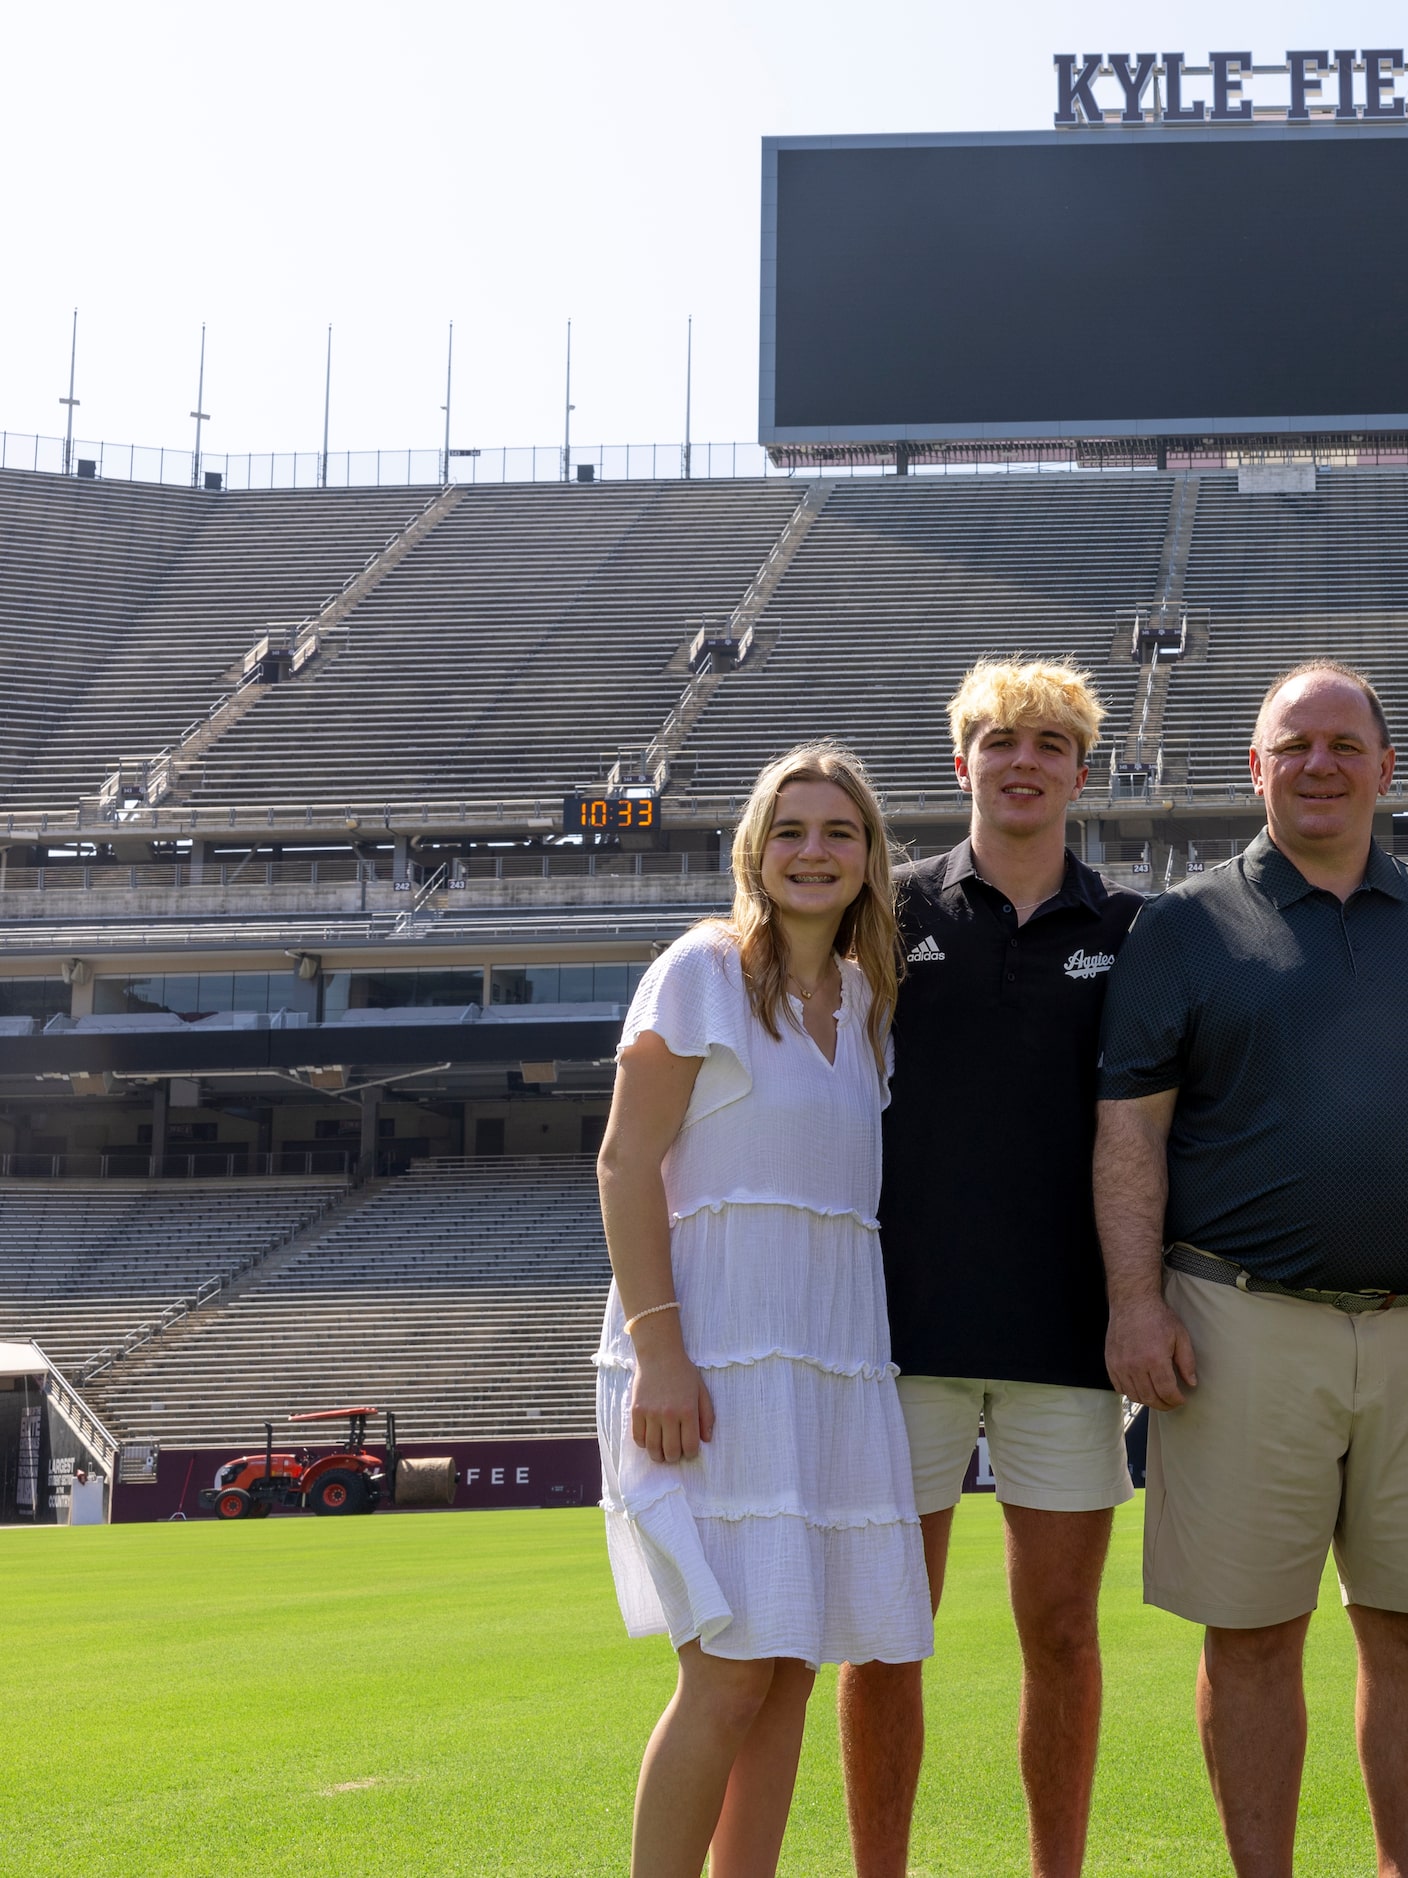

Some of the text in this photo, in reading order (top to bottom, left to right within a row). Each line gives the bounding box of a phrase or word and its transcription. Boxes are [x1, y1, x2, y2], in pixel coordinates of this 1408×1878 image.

[1054, 52, 1253, 124] KYLE
[394, 883, 410, 891] 242
[449, 881, 465, 889] 243
[906, 951, 946, 962] adidas
[1063, 949, 1116, 979] Aggies
